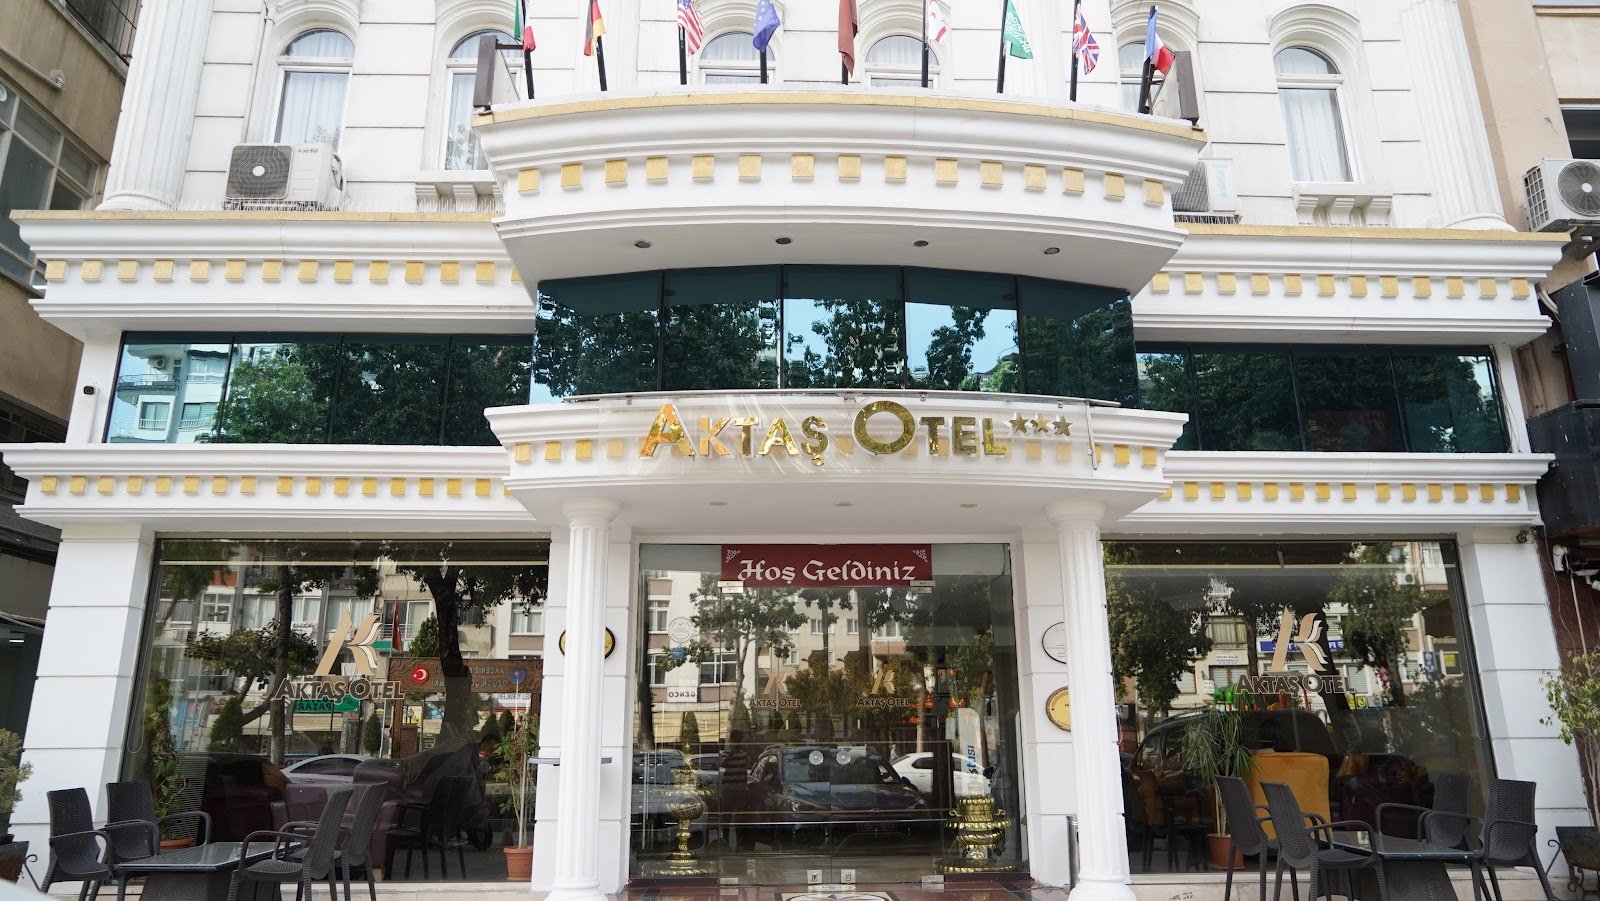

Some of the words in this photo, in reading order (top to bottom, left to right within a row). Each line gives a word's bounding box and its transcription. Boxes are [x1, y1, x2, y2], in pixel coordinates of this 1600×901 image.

[638, 403, 829, 467] AKTAŞ
[852, 400, 1006, 457] OTEL
[737, 559, 796, 585] Hoş
[802, 559, 916, 582] Geldiniz
[274, 677, 347, 705] AKTAŞ
[349, 678, 405, 701] OTEL
[1236, 674, 1300, 698] AKTAŞ
[1302, 673, 1356, 694] OTEL
[749, 698, 777, 709] AKTAŞ
[778, 698, 801, 708] OTEL
[856, 697, 887, 709] AKTAŞ
[887, 697, 910, 707] OTEL
